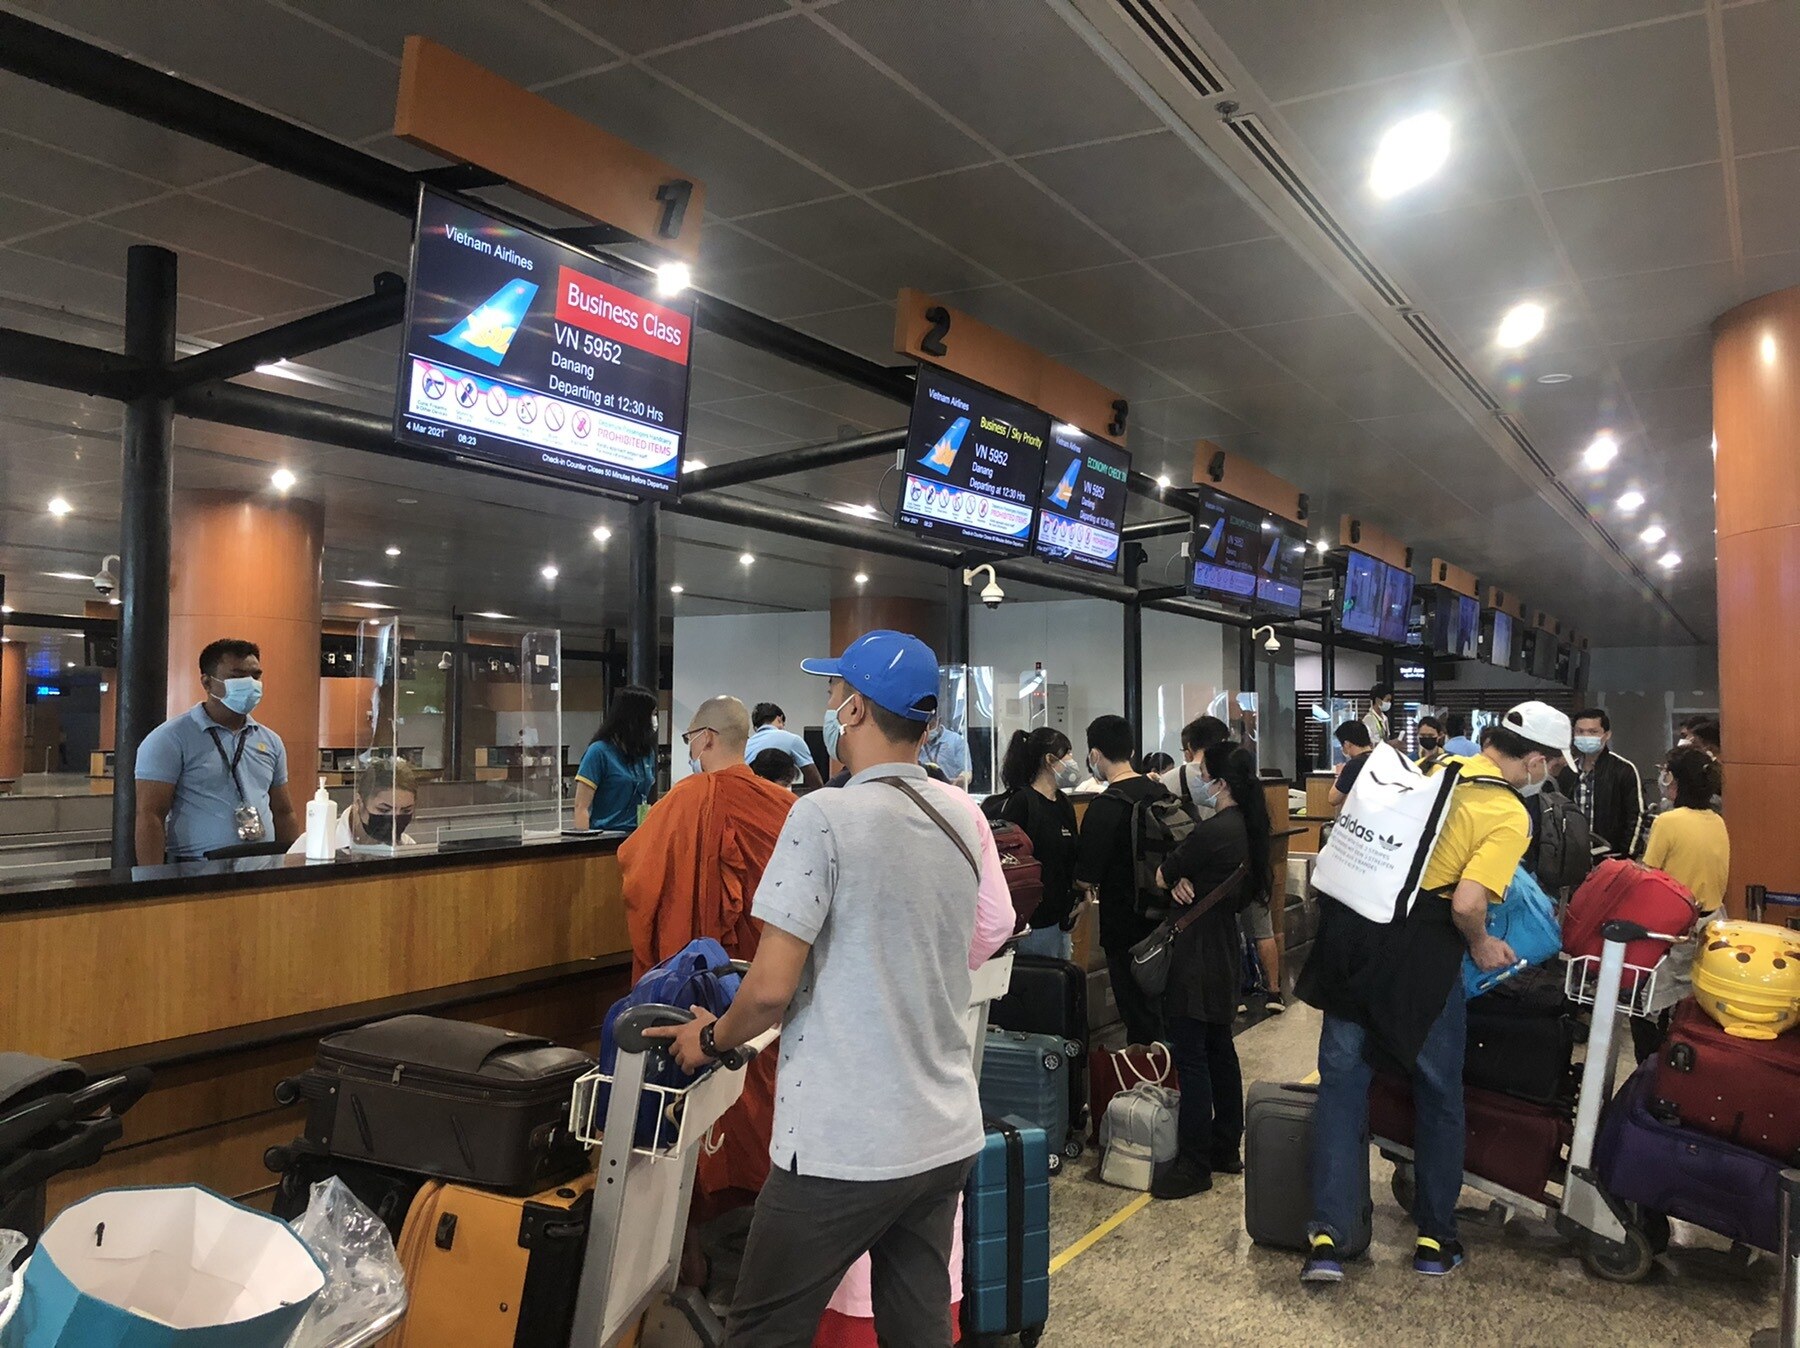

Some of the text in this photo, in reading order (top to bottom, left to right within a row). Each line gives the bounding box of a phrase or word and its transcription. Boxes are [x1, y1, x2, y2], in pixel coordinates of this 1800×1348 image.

[656, 179, 693, 240] 1
[445, 224, 534, 271] Vietnam Airlines
[567, 282, 682, 346] Business Class
[920, 306, 950, 356] 2
[554, 322, 622, 365] VN 5952
[551, 351, 595, 381] Danang
[549, 375, 664, 422] Departing at 12:30 Hrs
[928, 388, 970, 411] Vietnam Airlines
[406, 421, 445, 438] 4 Mar 2021
[980, 416, 1007, 436] Business
[1011, 428, 1022, 444] Sky
[1023, 432, 1043, 450] Priority
[1108, 399, 1128, 436] 3
[597, 427, 647, 450] PROHIBITED
[648, 441, 672, 457] ITEMS
[975, 443, 1009, 466] VN 5952
[542, 453, 669, 491] Check-in Counter Closes 50 Minutes Before Departure
[969, 477, 995, 495] Departing
[972, 461, 994, 479] Danang
[1338, 813, 1375, 842] didas
